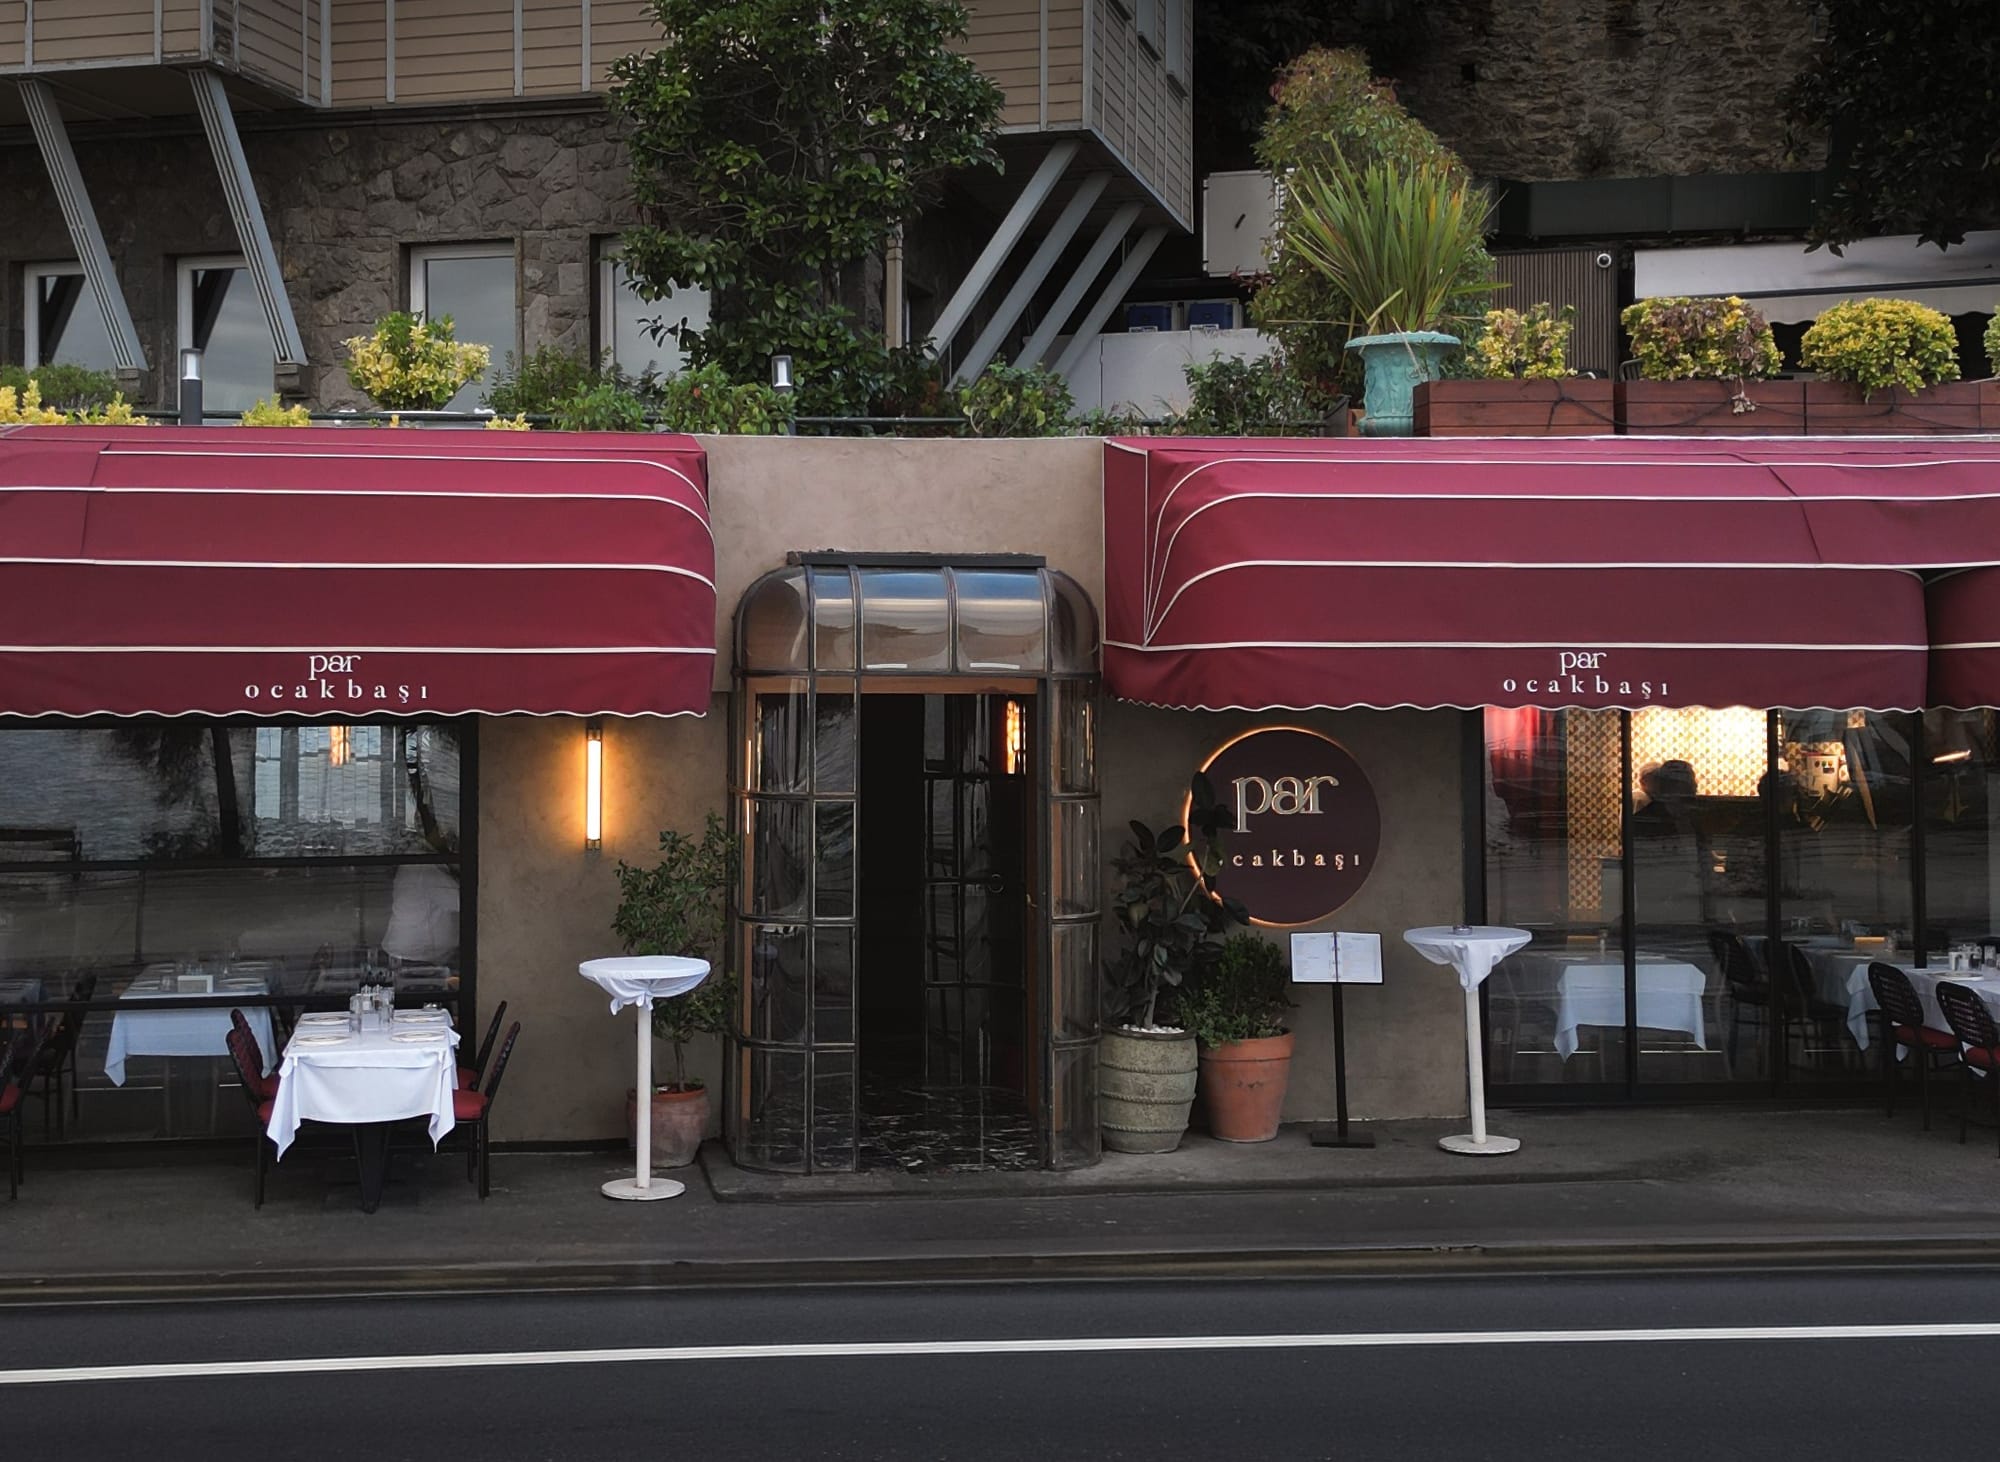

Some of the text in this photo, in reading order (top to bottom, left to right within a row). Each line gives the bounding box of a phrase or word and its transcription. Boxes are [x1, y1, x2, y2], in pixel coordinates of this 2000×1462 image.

[308, 654, 361, 681] par
[1559, 650, 1607, 676] par
[245, 678, 428, 703] ocakbaşı
[1503, 674, 1668, 699] ocakbaşı
[1231, 775, 1340, 834] par
[1218, 848, 1360, 871] cakbaşı
